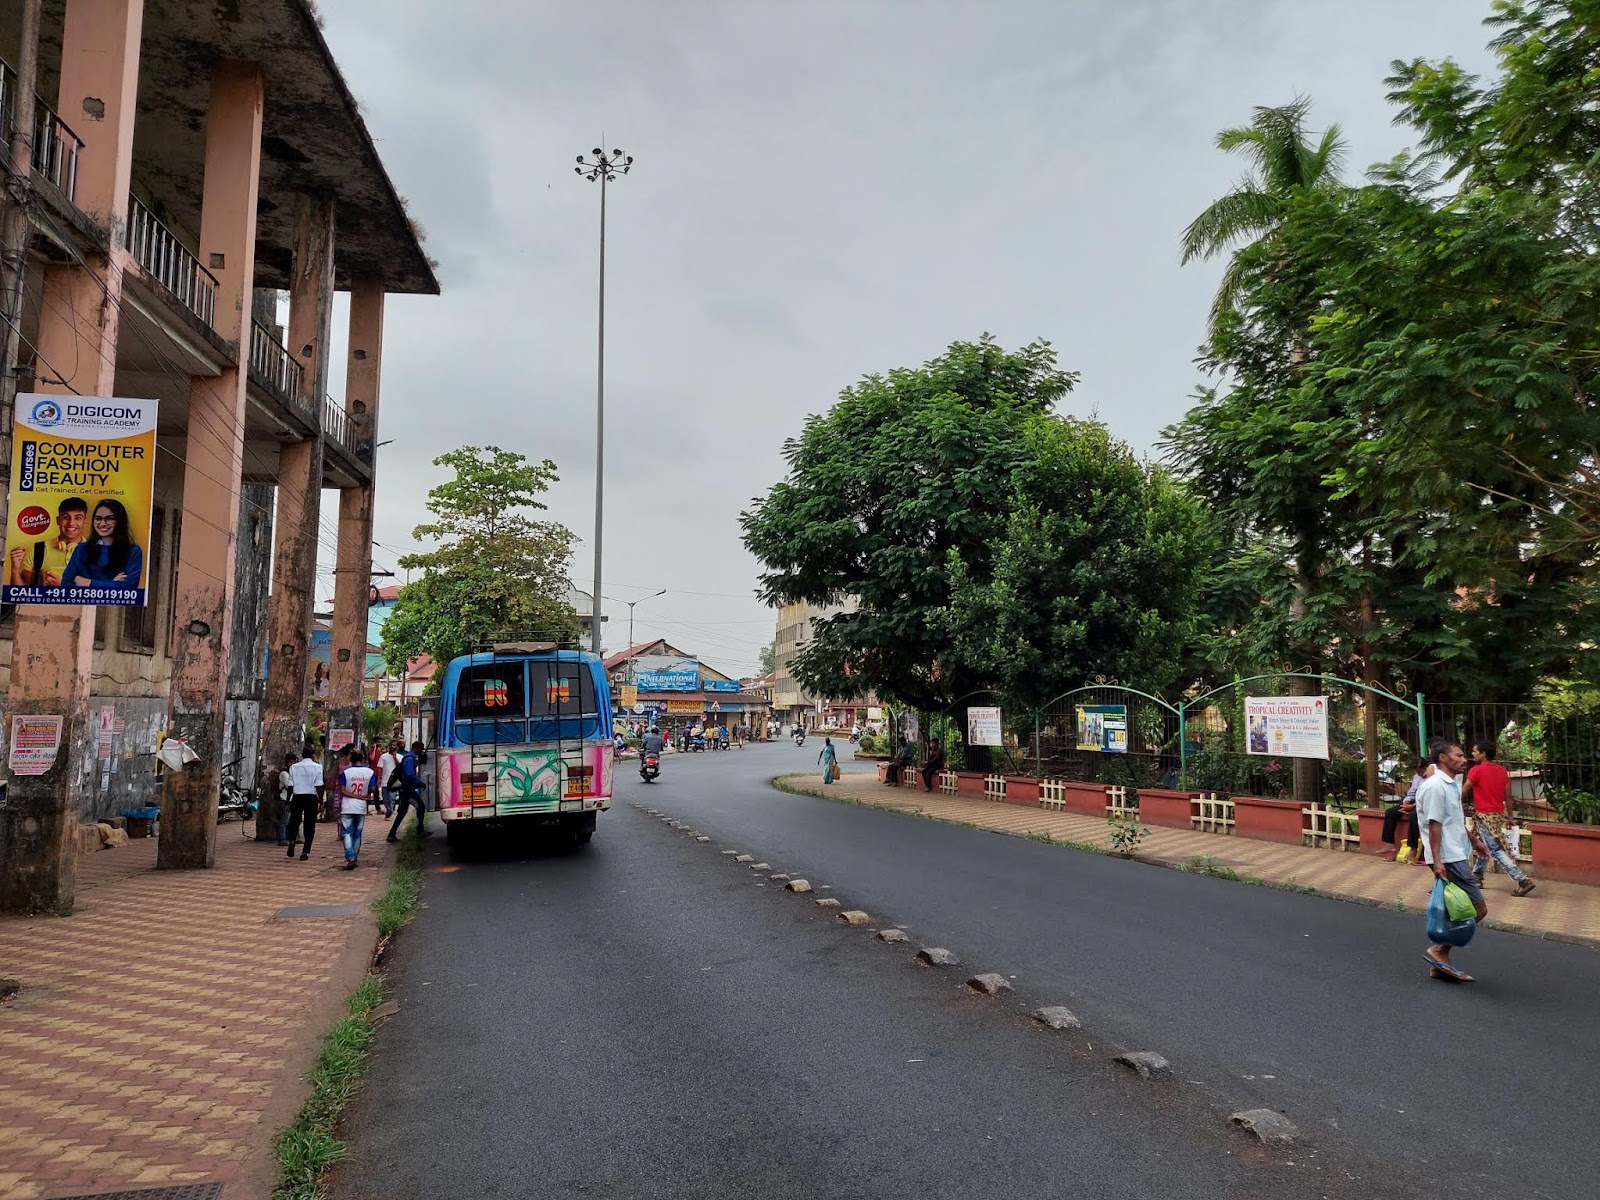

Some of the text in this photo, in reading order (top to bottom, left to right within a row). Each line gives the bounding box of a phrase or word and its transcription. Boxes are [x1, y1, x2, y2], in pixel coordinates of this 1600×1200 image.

[67, 405, 141, 419] DIGICOM
[67, 417, 140, 427] TRAINING ACADEMY
[38, 442, 144, 459] COMPUTER
[21, 444, 35, 489] Courses
[37, 456, 119, 472] FASHION
[36, 471, 109, 487] BEAUTY
[21, 513, 47, 524] Govt.
[10, 587, 138, 600] CALL +91 9158019190
[484, 679, 509, 707] R
[1248, 706, 1313, 715] TROPICAL CREATIVITY
[351, 783, 364, 796] 26
